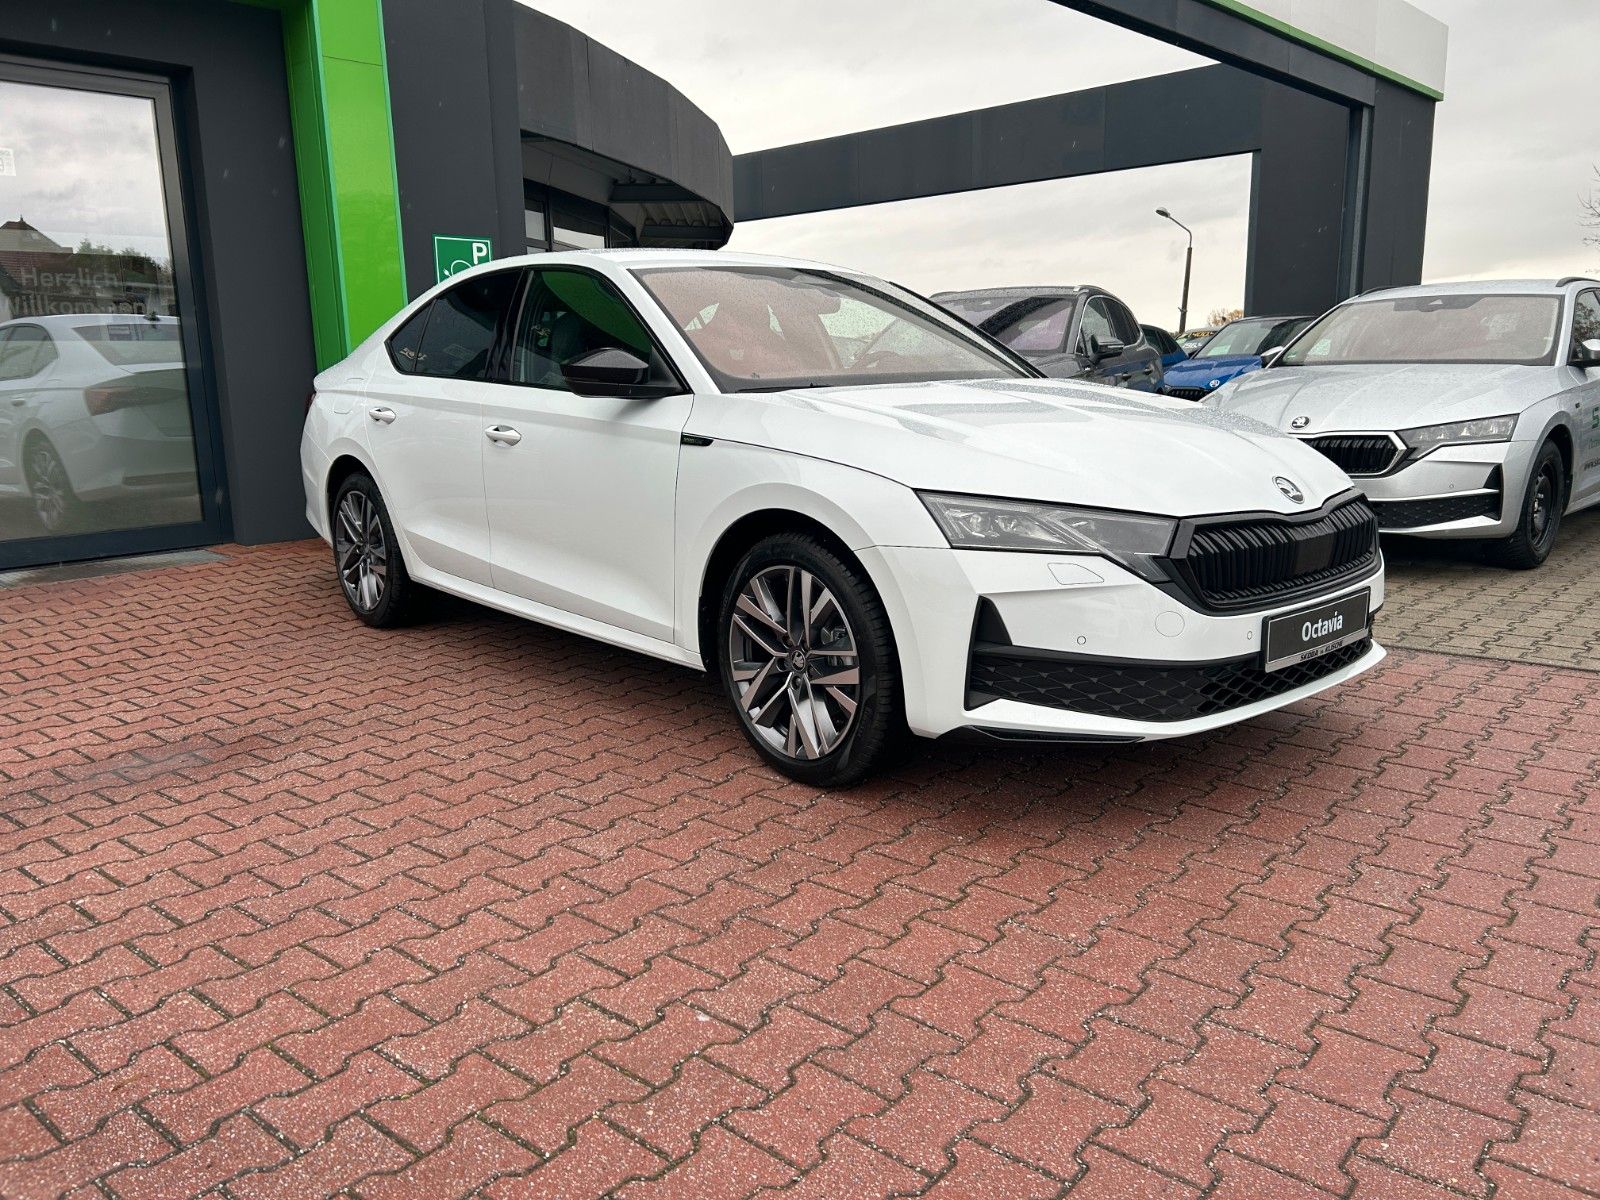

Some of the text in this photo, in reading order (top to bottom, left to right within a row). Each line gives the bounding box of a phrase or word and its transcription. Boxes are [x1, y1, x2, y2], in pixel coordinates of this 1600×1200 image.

[472, 242, 488, 265] P
[21, 266, 119, 288] Herzlich
[1301, 611, 1343, 642] Octavia
